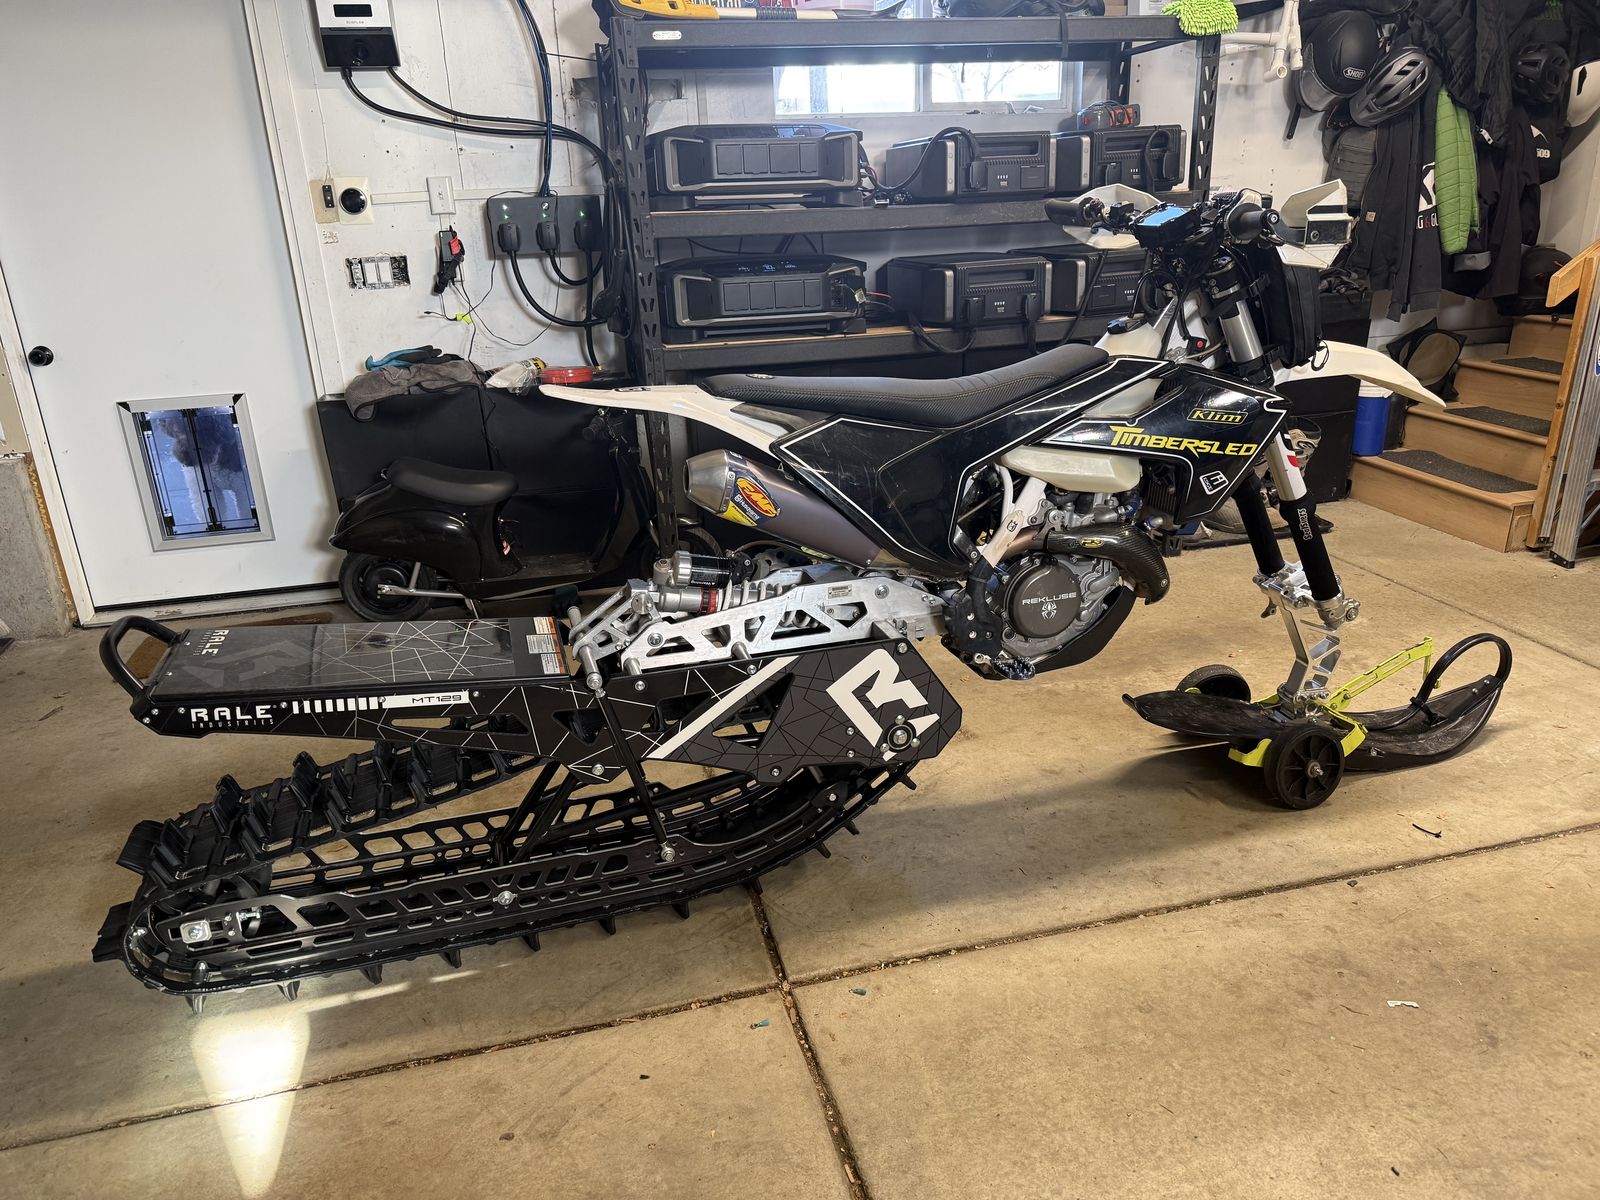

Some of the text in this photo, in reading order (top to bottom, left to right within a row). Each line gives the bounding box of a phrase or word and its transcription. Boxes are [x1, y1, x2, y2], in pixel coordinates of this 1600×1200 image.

[736, 478, 777, 516] FMF
[1022, 592, 1077, 605] REKLUSE
[201, 629, 229, 655] RALE
[411, 694, 462, 704] MT129
[190, 705, 273, 722] RALE
[191, 719, 274, 729] INDUSTRIES
